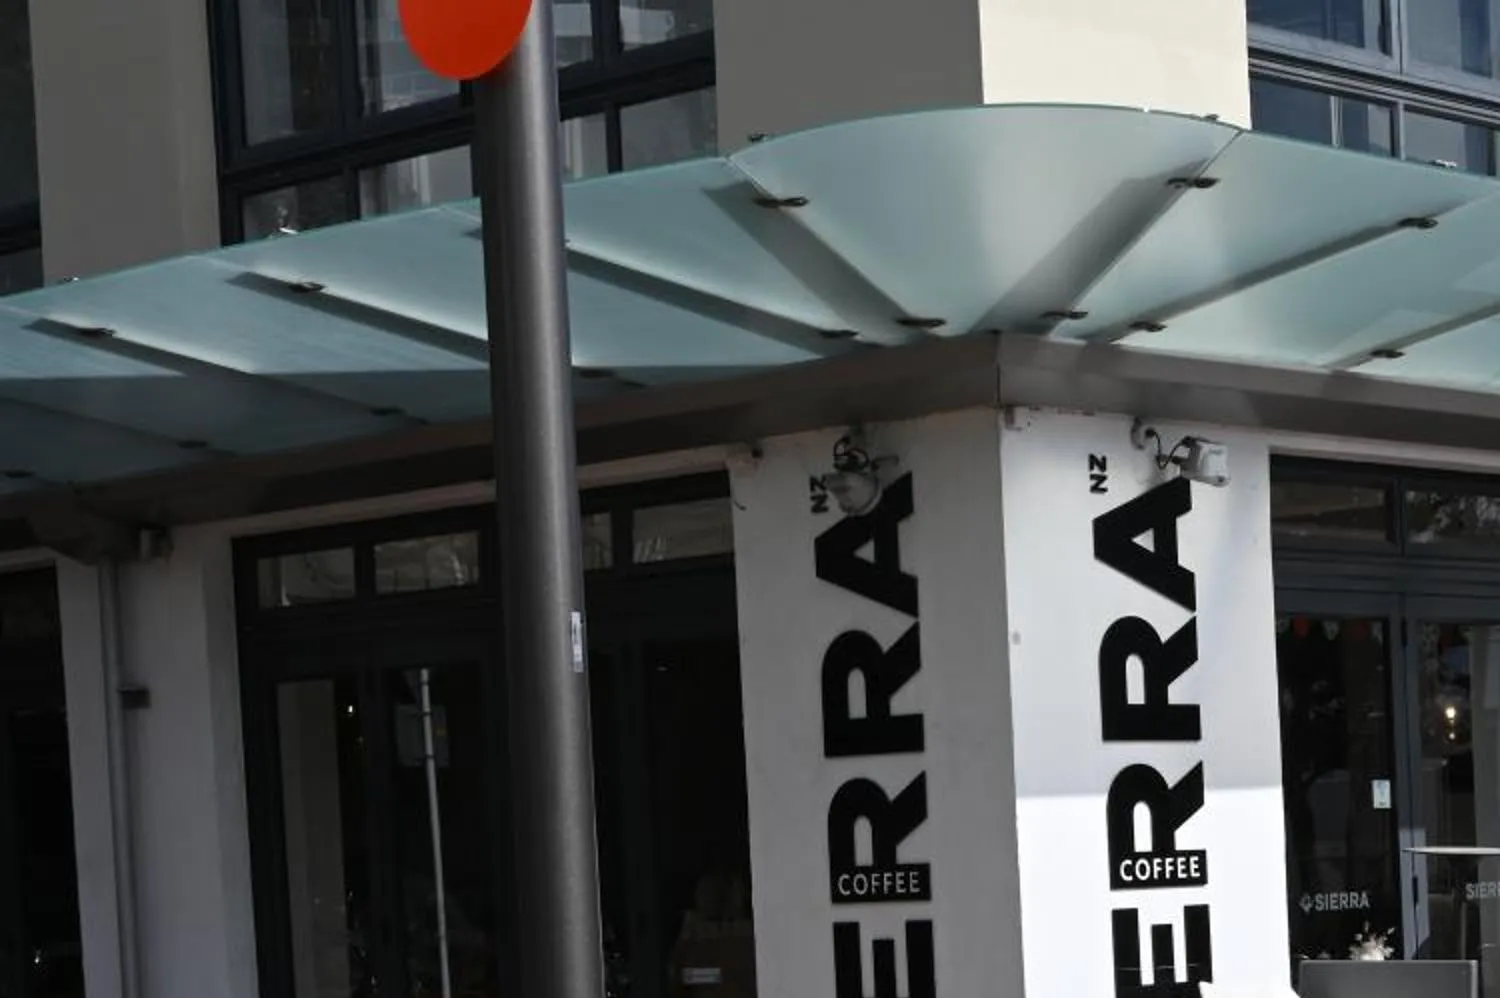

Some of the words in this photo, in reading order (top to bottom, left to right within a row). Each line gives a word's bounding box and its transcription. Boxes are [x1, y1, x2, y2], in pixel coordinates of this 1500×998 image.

[1088, 453, 1108, 494] NZ
[810, 474, 830, 515] NZ
[1118, 856, 1201, 882] COFFEE
[837, 872, 921, 897] COFFEE
[1313, 891, 1370, 913] SIERRA
